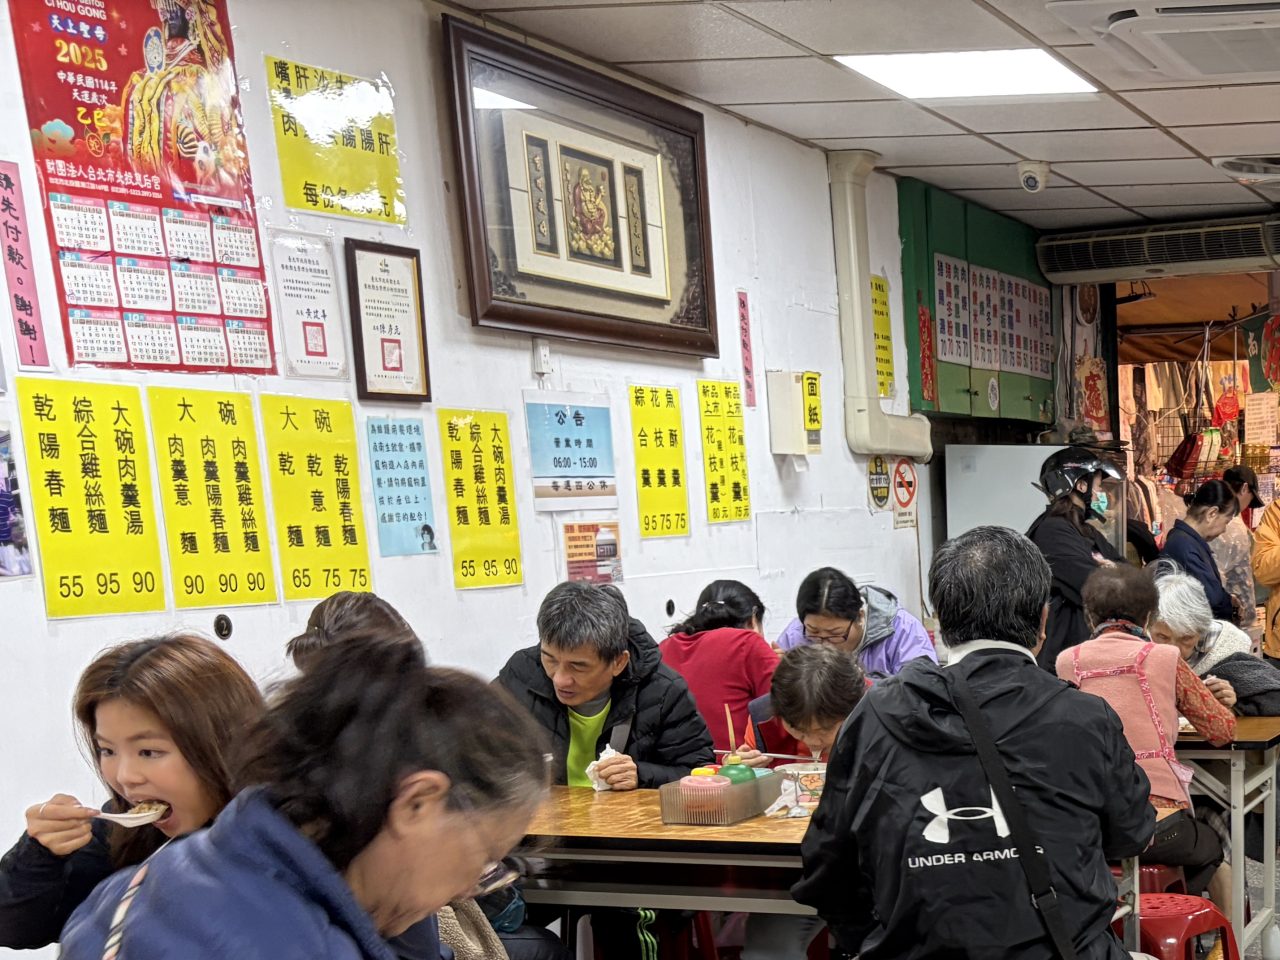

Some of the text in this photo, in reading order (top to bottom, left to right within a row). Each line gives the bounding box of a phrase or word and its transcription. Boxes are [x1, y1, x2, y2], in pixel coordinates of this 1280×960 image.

[77, 5, 107, 20] GONG
[55, 40, 108, 71] 2025
[57, 71, 118, 93] 中華民國114年
[177, 398, 237, 426] 大碗
[280, 405, 332, 433] 大碗
[555, 410, 585, 427] 公告
[806, 376, 820, 425] 面紙
[32, 393, 72, 534] 乾陽春麵
[73, 396, 109, 535] 綜合雞絲麵
[111, 400, 144, 536] 大碗肉羹湯
[553, 457, 571, 468] 06:00
[579, 457, 598, 468] 15:00
[554, 437, 595, 448] 營業時間
[634, 386, 652, 488] 綜合羹
[650, 387, 667, 488] 花枝羹
[665, 388, 682, 488] 魚酥羹
[706, 426, 721, 503] 花枝羹
[728, 426, 743, 502] 花枝羹
[168, 433, 199, 554] 肉羹意麵
[200, 435, 231, 554] 肉羹陽春麵
[232, 436, 260, 553] 肉羹雞絲麵
[307, 453, 332, 548] 乾意麵
[334, 454, 358, 546] 乾陽春麵
[447, 422, 470, 526] 乾陽春麵
[470, 423, 490, 526] 綜合雞絲麵
[491, 423, 511, 525] 大碗肉羹湯
[551, 479, 609, 492] 每週四公休
[644, 512, 686, 531] 95 75 75
[59, 571, 155, 598] 55 95 90
[184, 571, 265, 595] 90 90 90
[292, 567, 367, 588] 65 75 75
[461, 558, 518, 577] 55 95 90
[908, 853, 966, 868] UNDER
